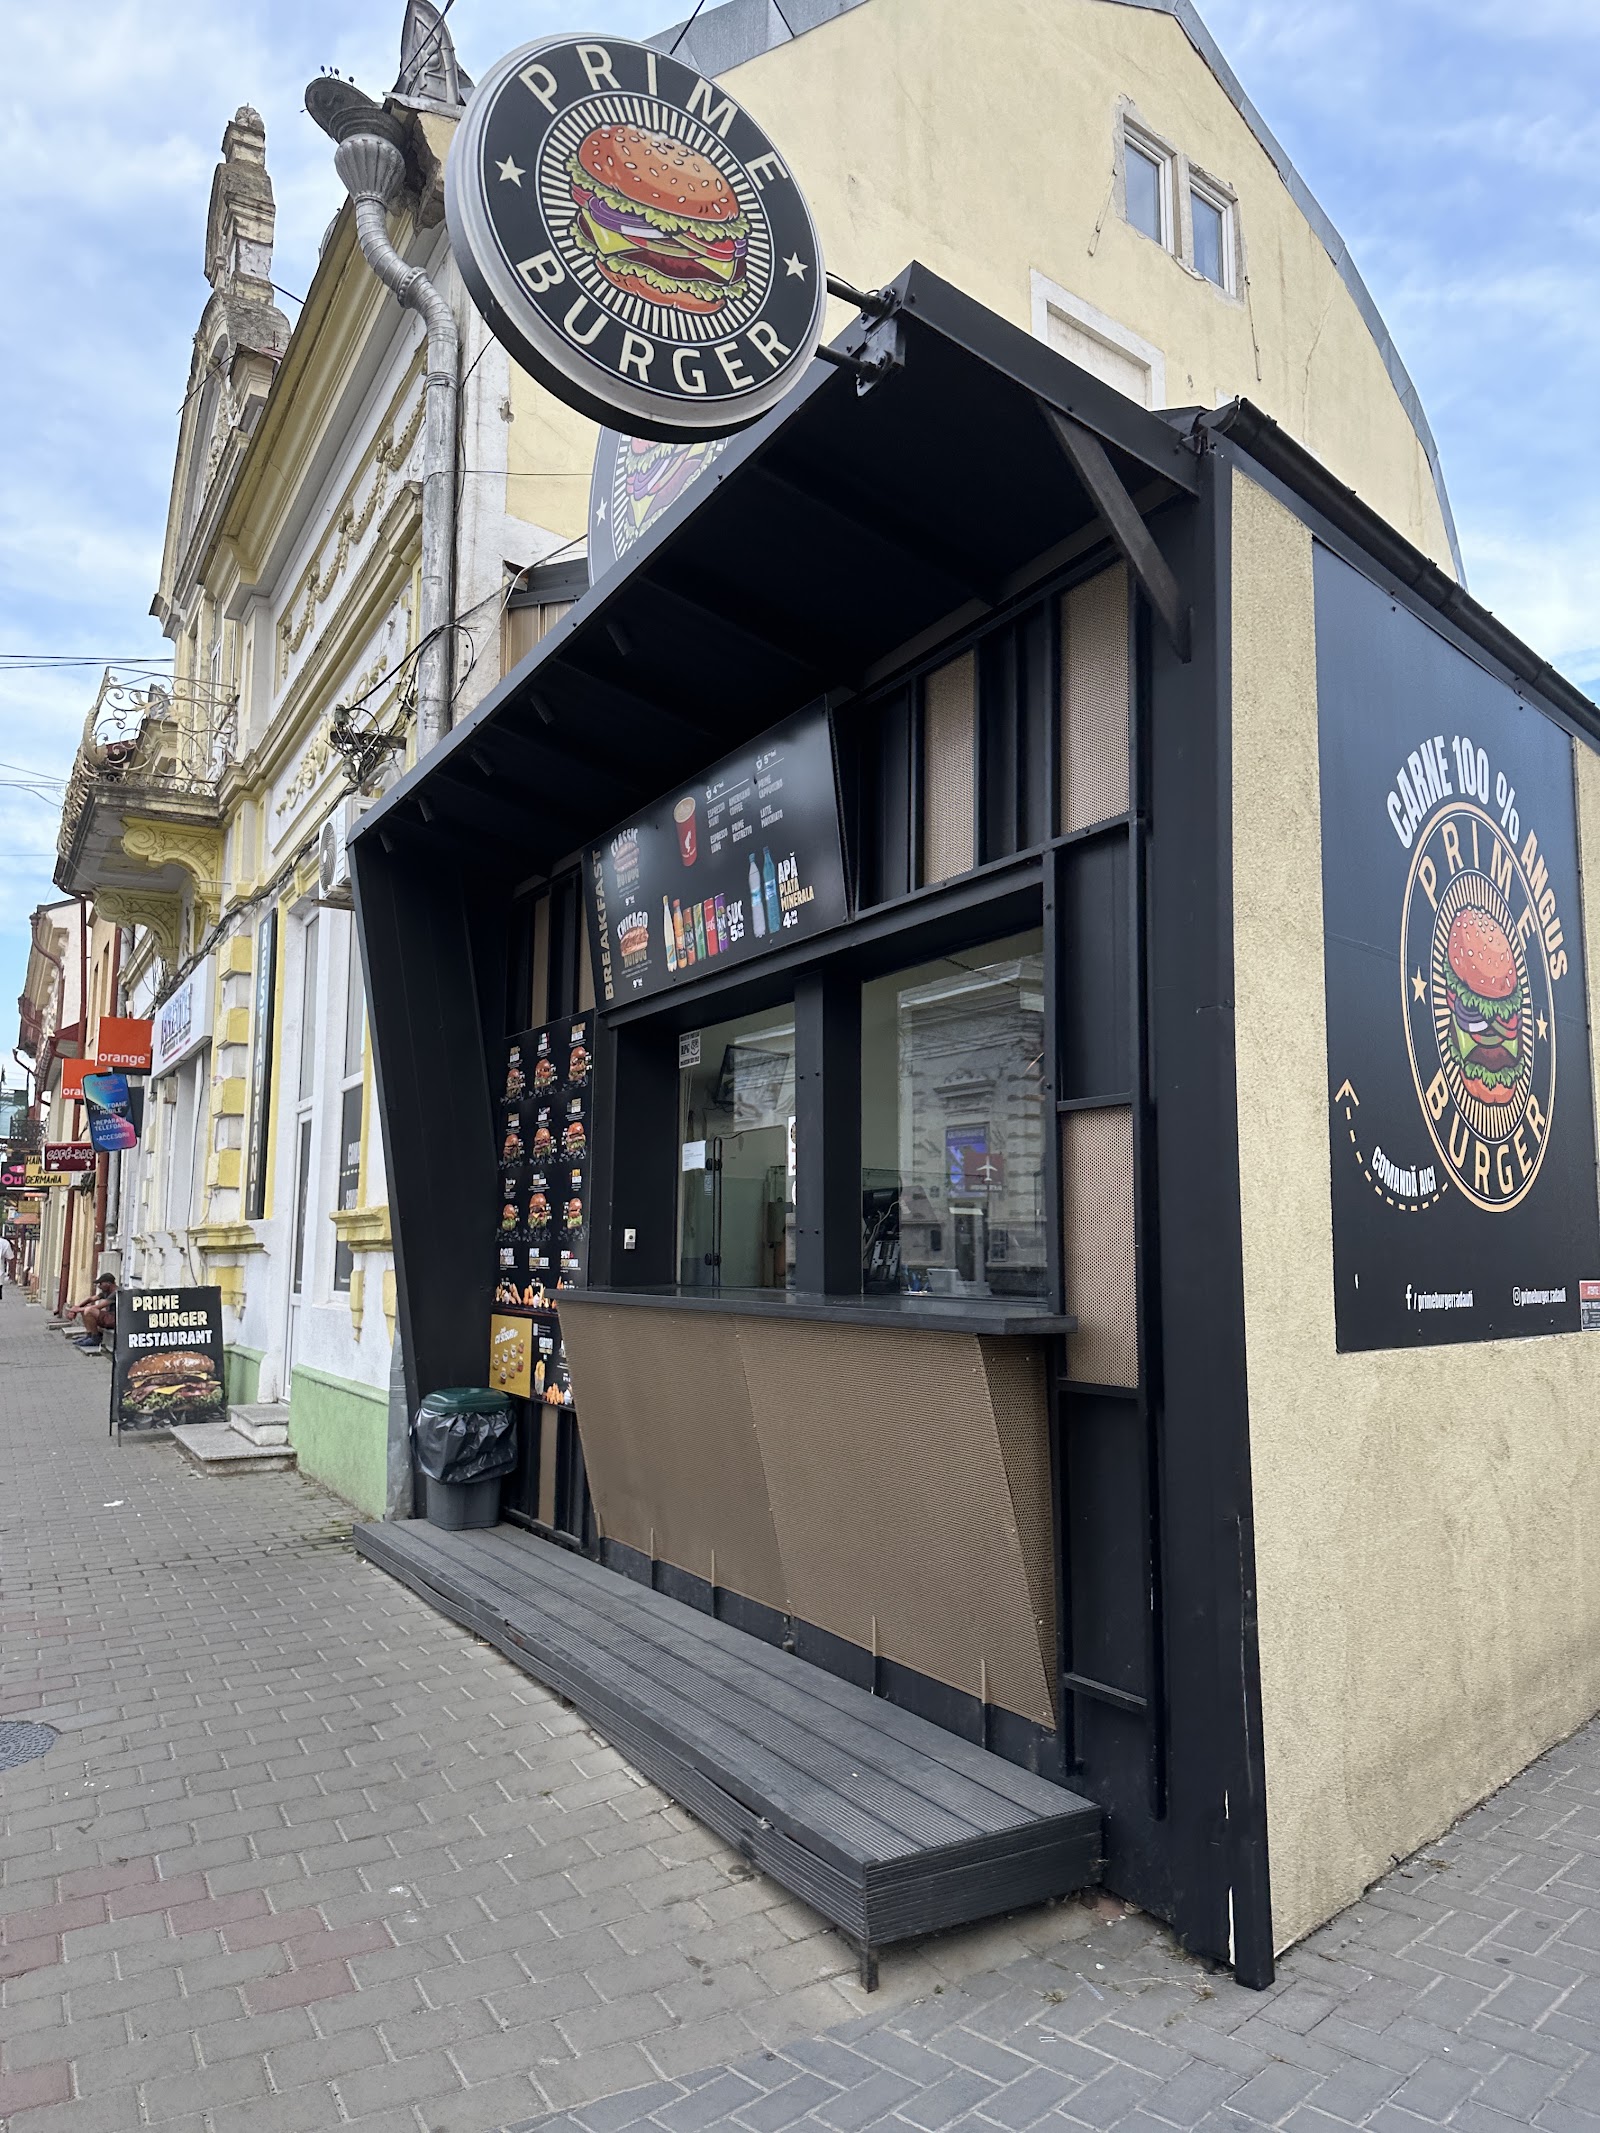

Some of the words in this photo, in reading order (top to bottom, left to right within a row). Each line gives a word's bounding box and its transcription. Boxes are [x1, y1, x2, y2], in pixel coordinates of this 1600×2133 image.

[519, 43, 789, 191] PRIME
[516, 249, 790, 395] BURGER
[611, 827, 639, 858] CLASSIC
[1387, 735, 1453, 849] CARNE
[1452, 735, 1490, 804] 100
[1521, 829, 1568, 980] ANGUS
[777, 851, 798, 884] APĂ
[779, 876, 800, 897] PLATA
[780, 885, 815, 912] MINERALA
[1418, 820, 1535, 951] PRIME
[592, 850, 614, 1000] BREAKFAST
[617, 911, 648, 940] CHICAGO
[726, 899, 744, 926] SUC
[98, 1053, 146, 1065] orange
[249, 922, 269, 1212] RESTAURANT
[100, 1107, 122, 1115] MOBILE
[1425, 1068, 1545, 1194] BURGER
[1372, 1146, 1419, 1197] COMANDĂ
[1419, 1165, 1437, 1196] AICI
[132, 1295, 179, 1311] PRIME
[148, 1311, 208, 1328] BURGER
[128, 1330, 213, 1348] RESTAURANT
